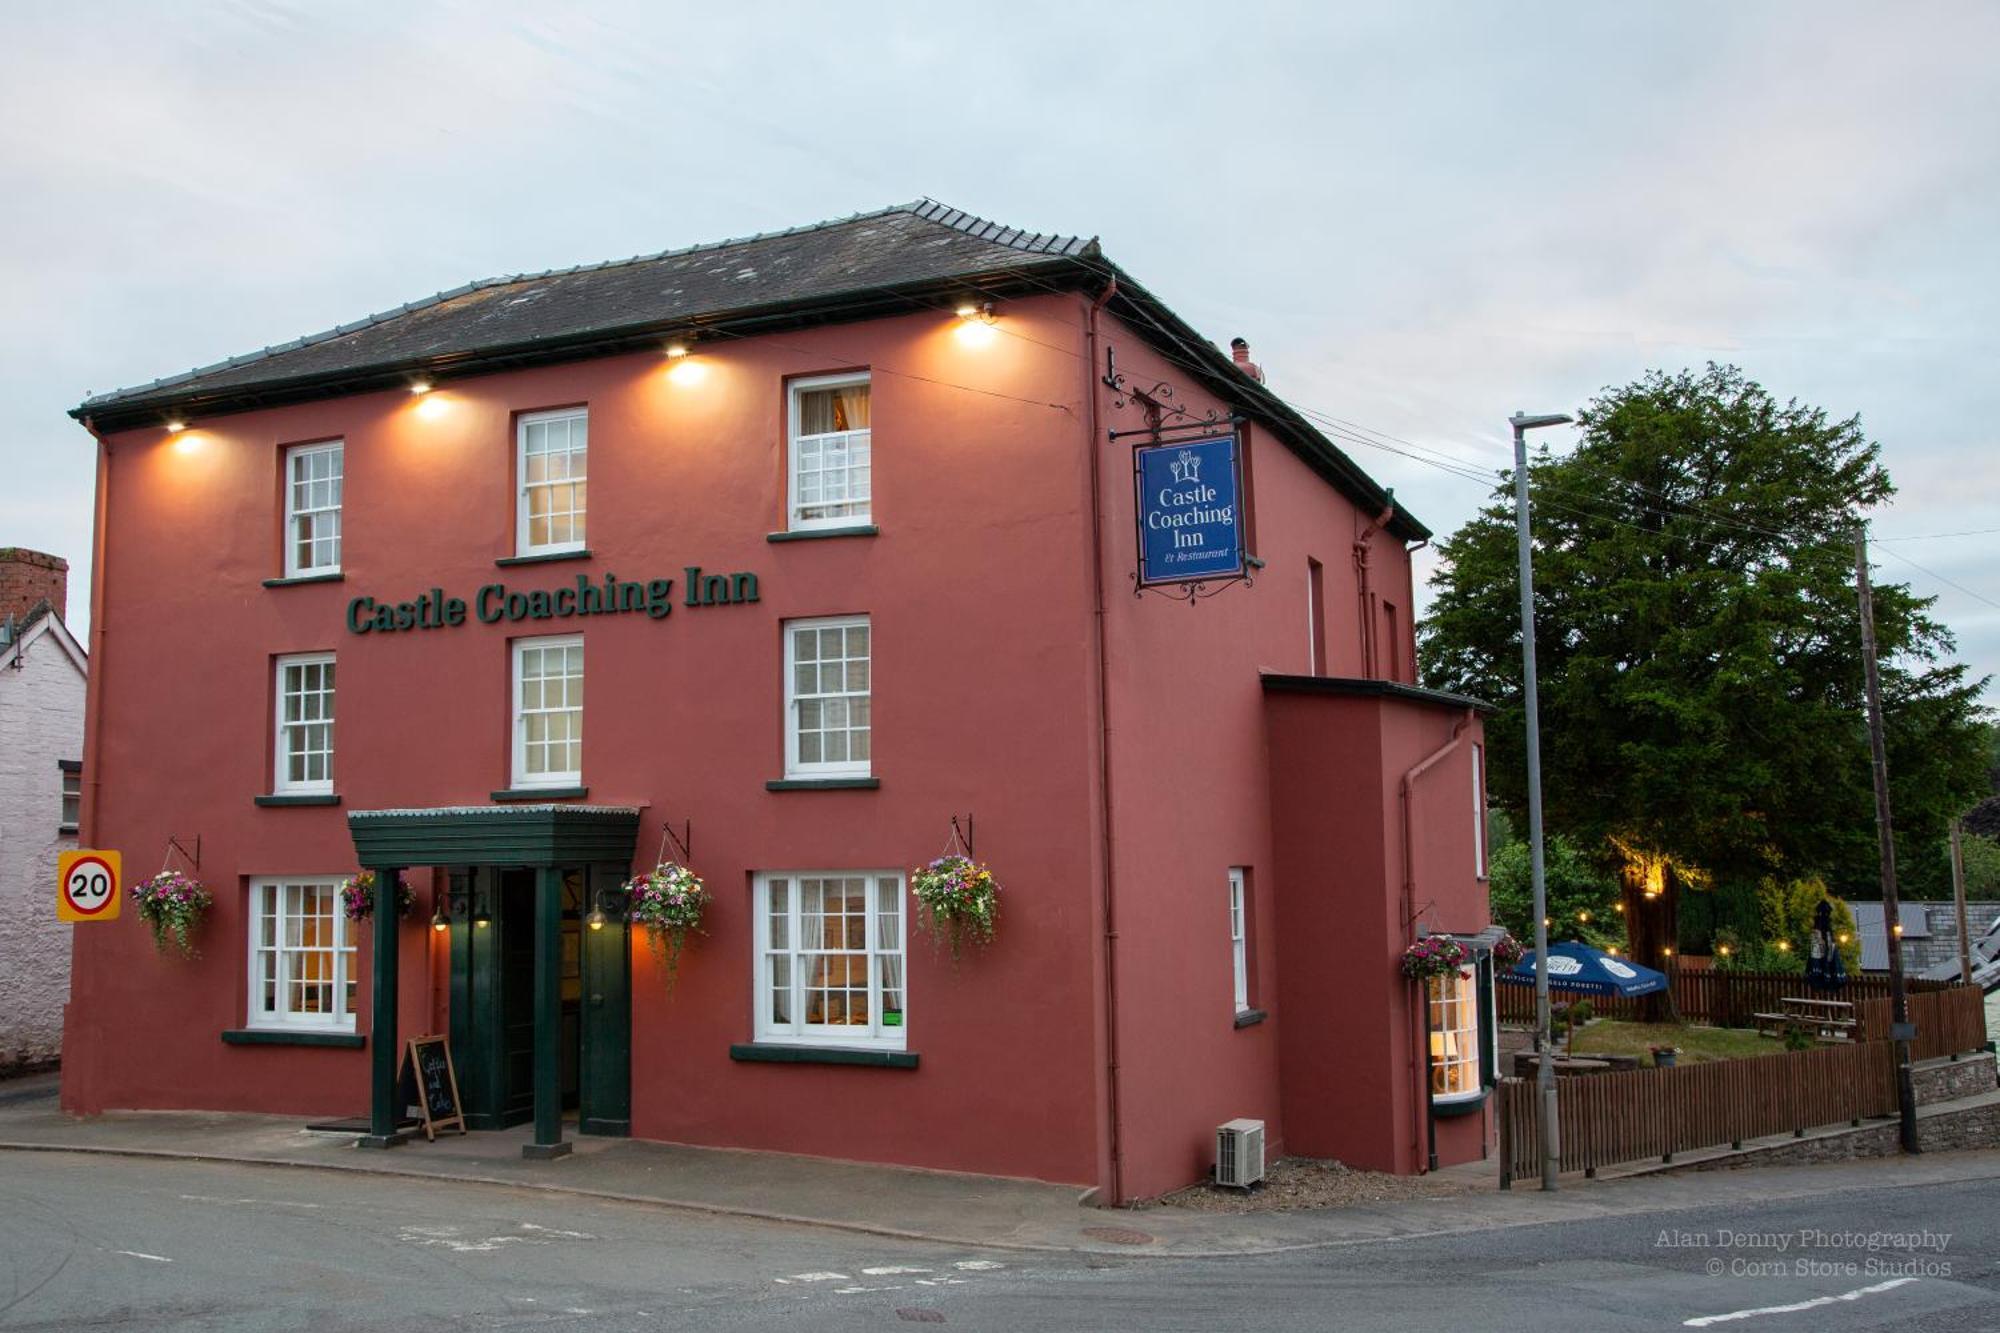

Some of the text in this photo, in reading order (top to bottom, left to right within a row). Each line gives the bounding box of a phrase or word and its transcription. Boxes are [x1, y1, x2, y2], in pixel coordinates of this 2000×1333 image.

[1159, 485, 1216, 507] Castle
[1149, 504, 1233, 529] Coaching
[1174, 529, 1204, 548] Inn
[1177, 548, 1228, 562] Restaurant
[347, 566, 761, 634] Castle Coaching Inn
[72, 873, 107, 897] 20
